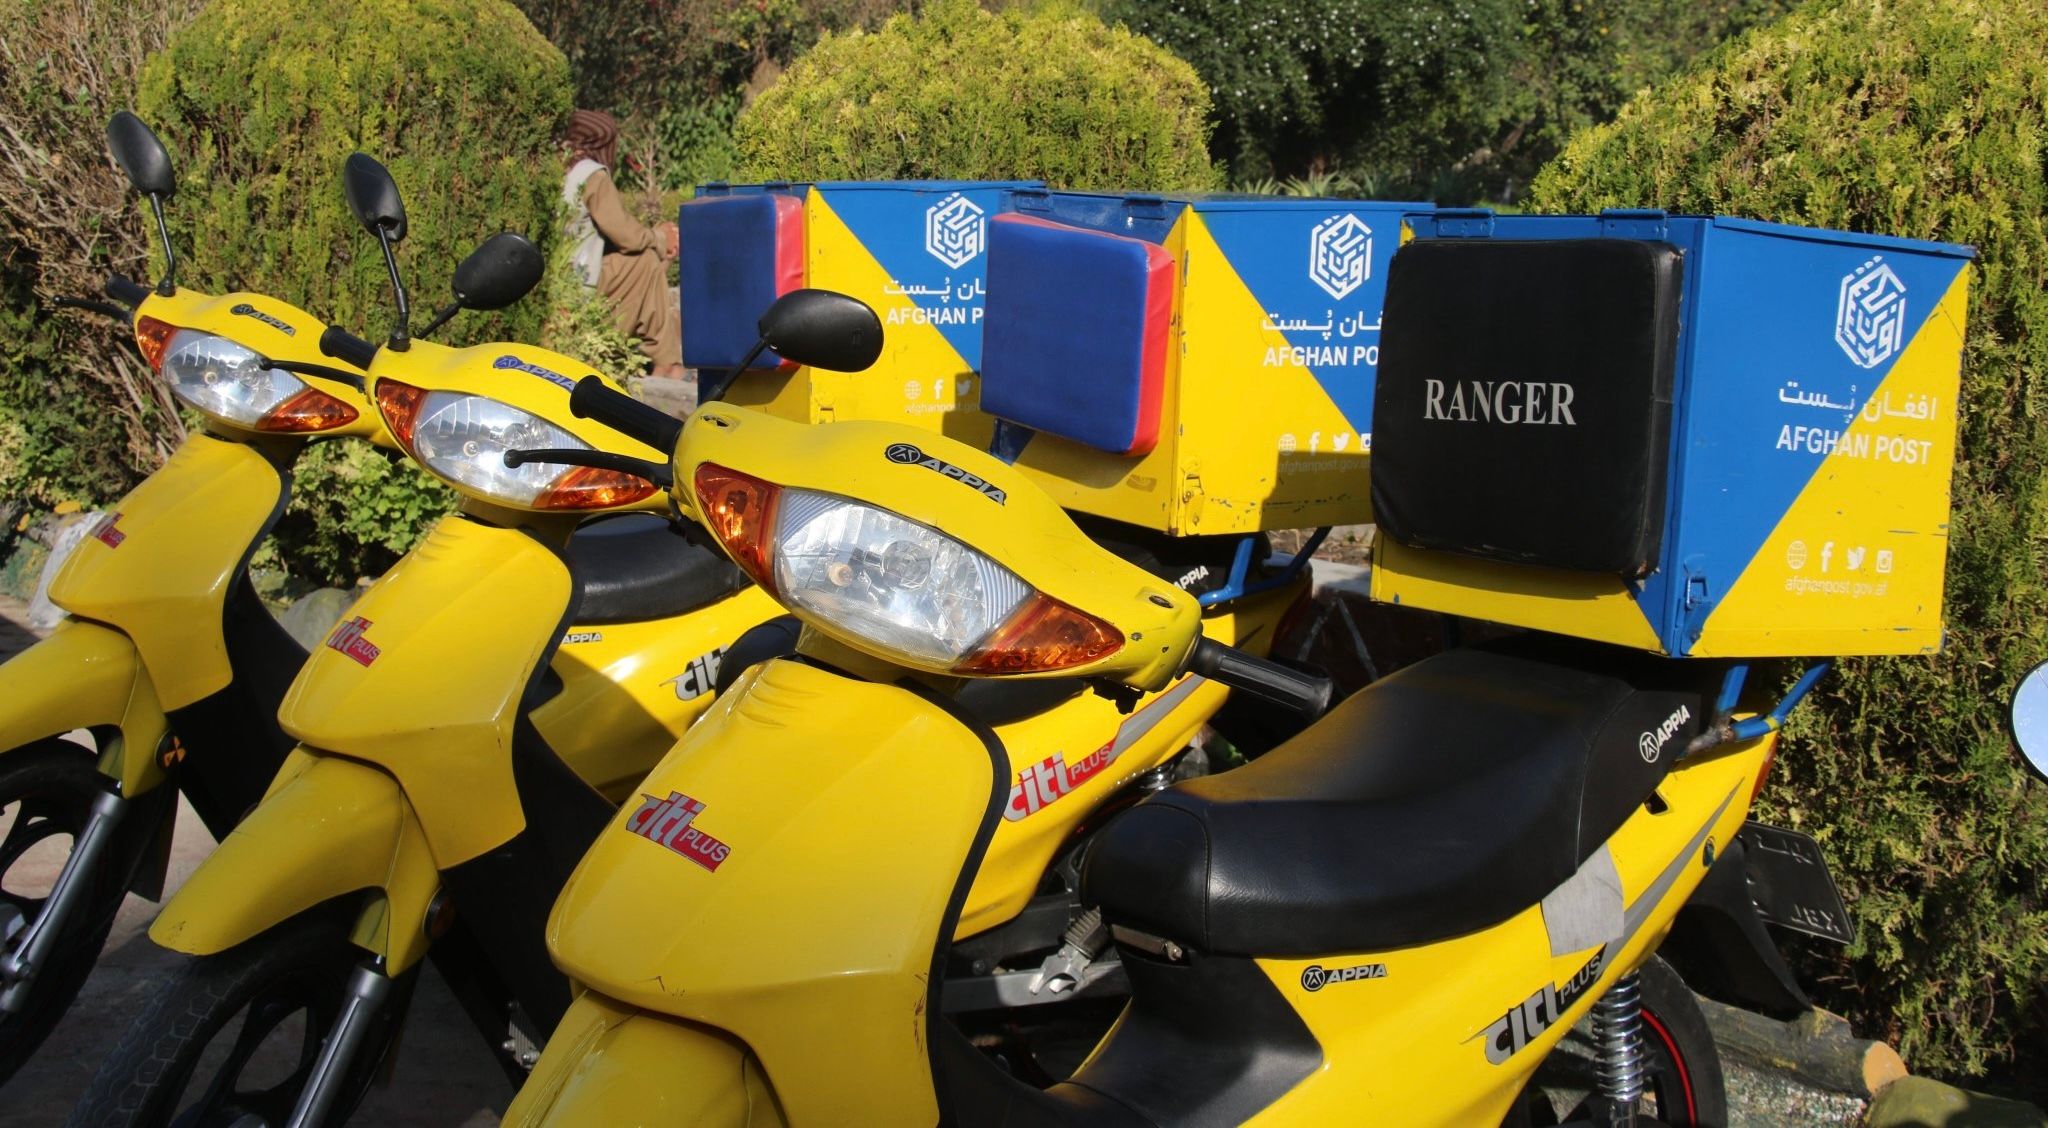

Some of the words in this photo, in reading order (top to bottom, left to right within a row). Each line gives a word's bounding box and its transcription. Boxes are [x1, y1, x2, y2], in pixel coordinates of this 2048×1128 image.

[247, 311, 296, 337] APPIA
[886, 307, 966, 325] AFGHAN
[1263, 346, 1348, 367] AFGHAN
[1353, 346, 1379, 366] PO
[513, 363, 577, 392] APPIA
[1423, 379, 1577, 425] RANGER
[1862, 390, 1938, 423] افغان
[1776, 424, 1870, 459] AFGHAN
[1874, 435, 1932, 465] POST
[917, 458, 1006, 505] APPIA
[352, 637, 379, 660] PLUS
[561, 632, 602, 645] APPIA
[1656, 704, 1691, 748] APPIA
[1071, 745, 1111, 781] PLUS
[679, 828, 731, 862] PLUS
[1325, 963, 1388, 984] APPIA
[1560, 954, 1603, 1005] PLUS
